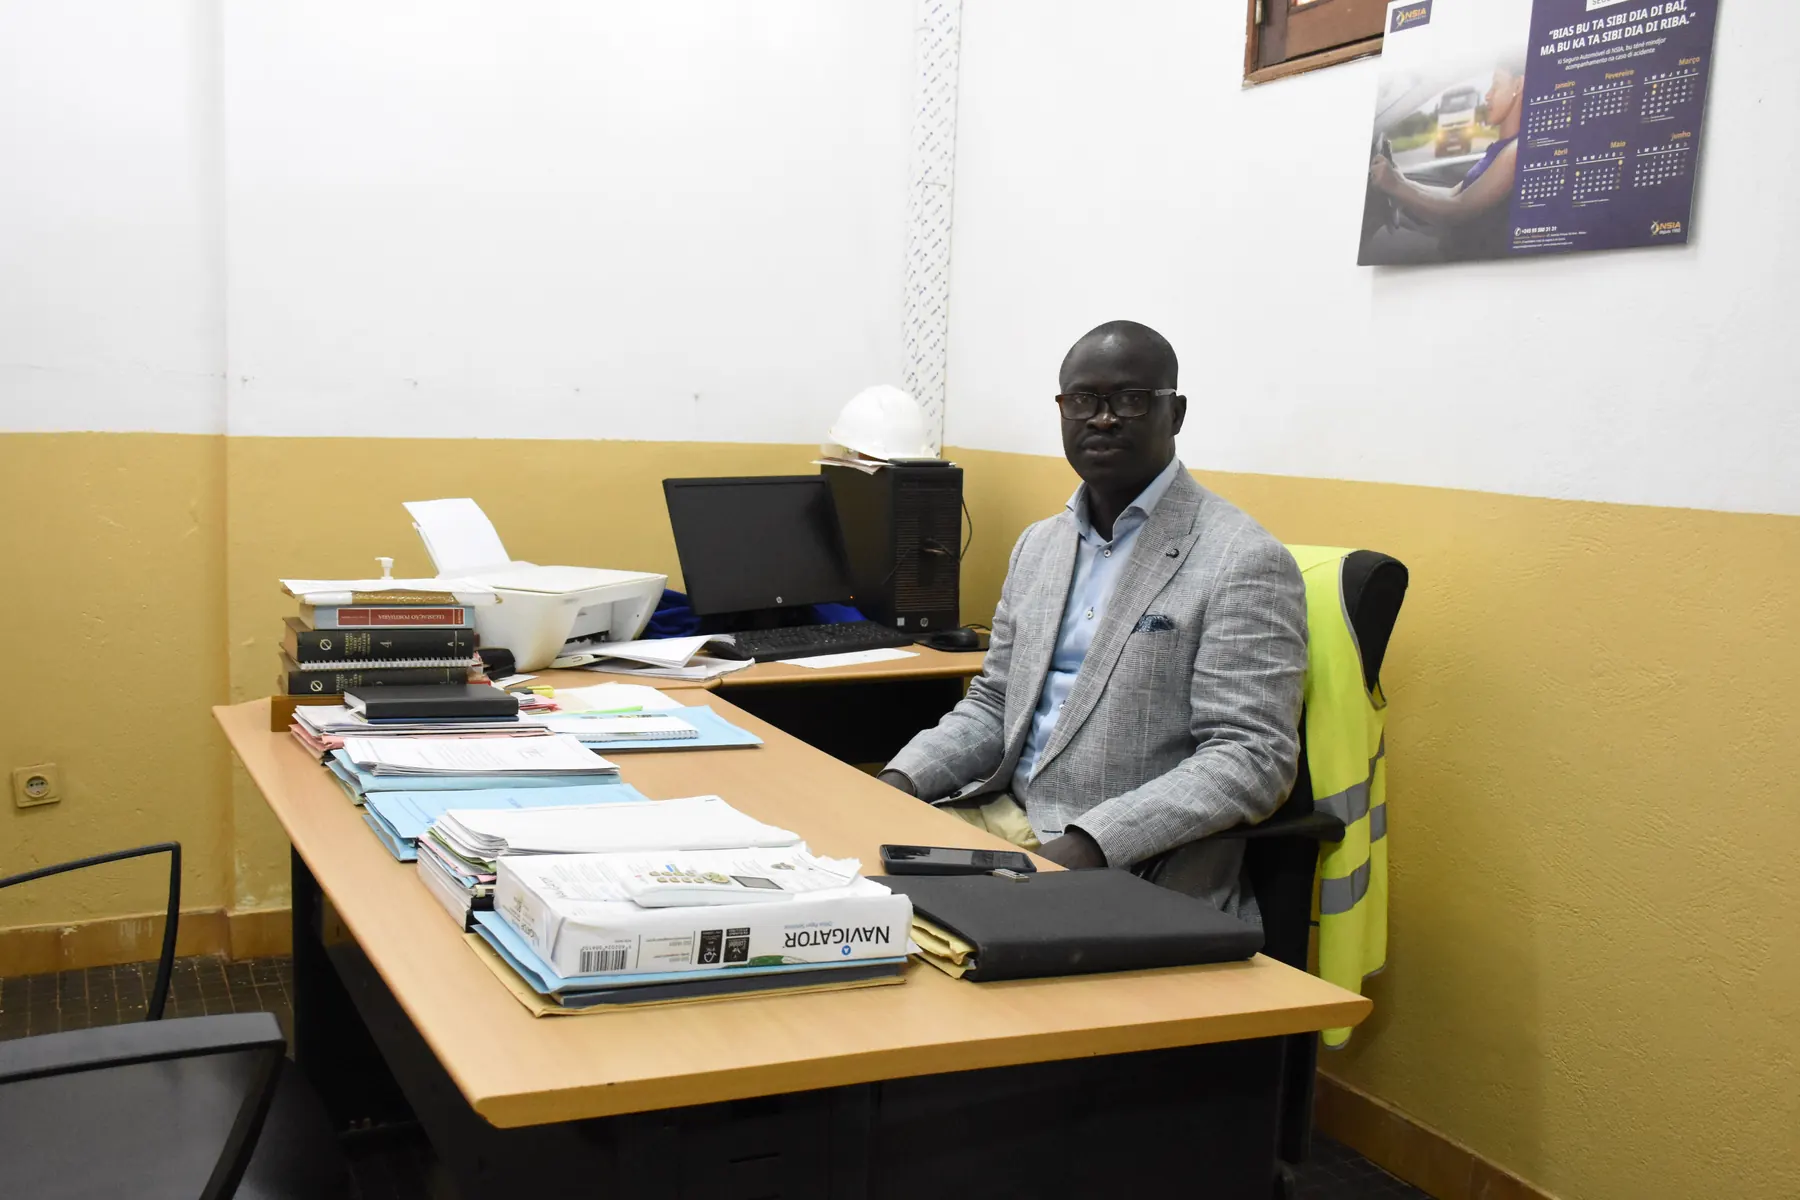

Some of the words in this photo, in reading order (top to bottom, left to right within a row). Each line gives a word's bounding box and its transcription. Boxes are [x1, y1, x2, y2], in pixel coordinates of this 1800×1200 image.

[1405, 8, 1427, 20] NSIA
[1576, 21, 1590, 34] BU
[1592, 20, 1605, 31] TA
[1606, 14, 1628, 28] SIBI
[1629, 10, 1648, 22] DIA
[1650, 5, 1664, 17] DI
[1540, 45, 1555, 56] MA
[1557, 41, 1571, 52] BU
[1572, 37, 1585, 49] KA
[1588, 35, 1600, 46] TA
[1602, 29, 1623, 43] SIBI
[1624, 24, 1643, 38] DIA
[1646, 22, 1658, 33] DI
[1563, 55, 1580, 64] Seguro
[1615, 53, 1627, 61] caso
[1633, 47, 1656, 57] acidente
[1678, 57, 1700, 66] Março
[1605, 69, 1634, 80] Fevereiro
[1555, 81, 1576, 91] Janeiro
[1554, 148, 1568, 156] Abril
[1660, 221, 1681, 229] NSIA
[784, 925, 890, 948] NAVIGATOR
